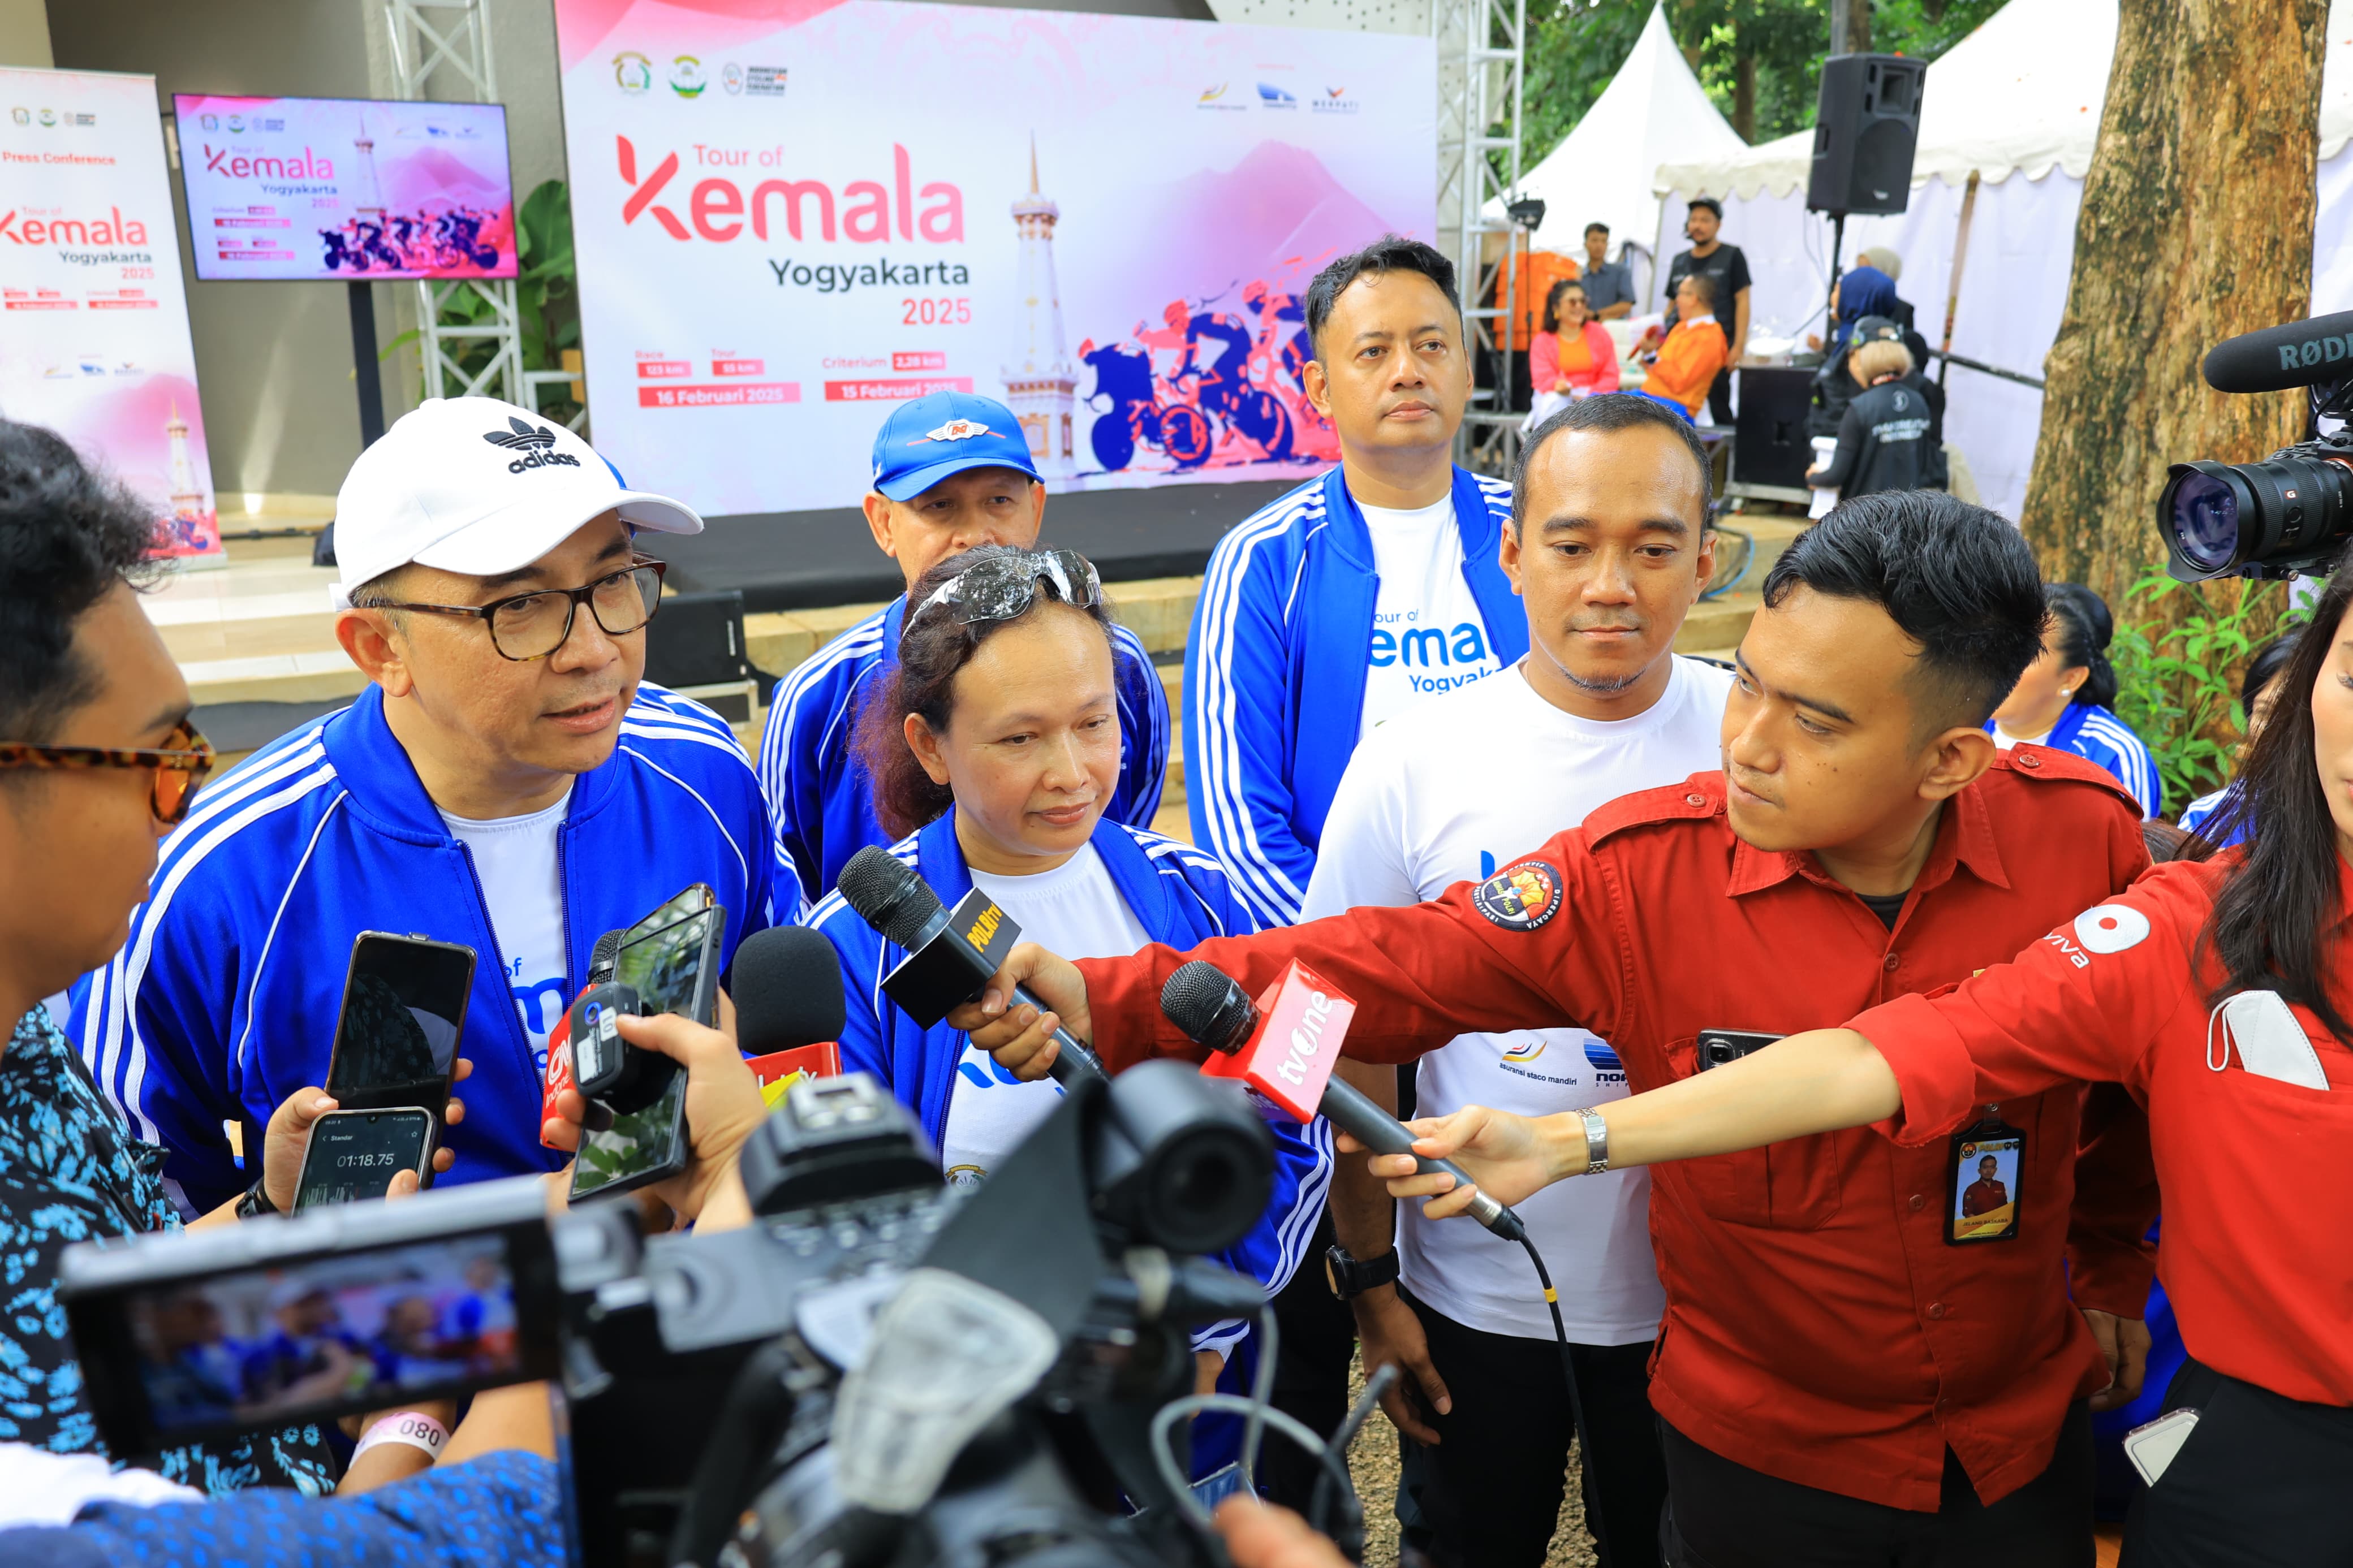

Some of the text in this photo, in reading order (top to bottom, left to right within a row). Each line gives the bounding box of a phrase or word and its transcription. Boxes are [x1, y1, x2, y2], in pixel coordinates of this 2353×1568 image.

[3, 152, 115, 166] Press Conference
[204, 144, 334, 179] Kemala
[693, 144, 785, 167] Tour of
[261, 184, 338, 196] Yogyakarta
[617, 135, 964, 243] Kemala
[22, 206, 62, 215] Tour of
[312, 198, 339, 208] 2025
[59, 250, 152, 265] Yogyakarta
[121, 267, 154, 279] 2025
[769, 258, 969, 293] Yogyakarta
[902, 299, 972, 325] 2025
[712, 349, 735, 357] Tour
[738, 363, 756, 372] km
[822, 357, 887, 368] Criterium
[923, 356, 943, 366] km
[657, 387, 784, 404] 16 Februari 2025
[842, 385, 857, 399] 15
[860, 383, 921, 399] Februari
[508, 450, 581, 474] adidas
[1374, 608, 1419, 623] our of
[1369, 623, 1488, 667] ema
[1502, 897, 1516, 914] POLRI
[1527, 889, 1561, 929] DIPERCAYA
[1276, 990, 1333, 1086] tvOne
[548, 1033, 572, 1086] CN
[1499, 1063, 1578, 1086] asuransi staco mandiri
[546, 1072, 571, 1109] Indone
[337, 1153, 395, 1168] 01:18.75
[400, 1419, 441, 1446] 080
